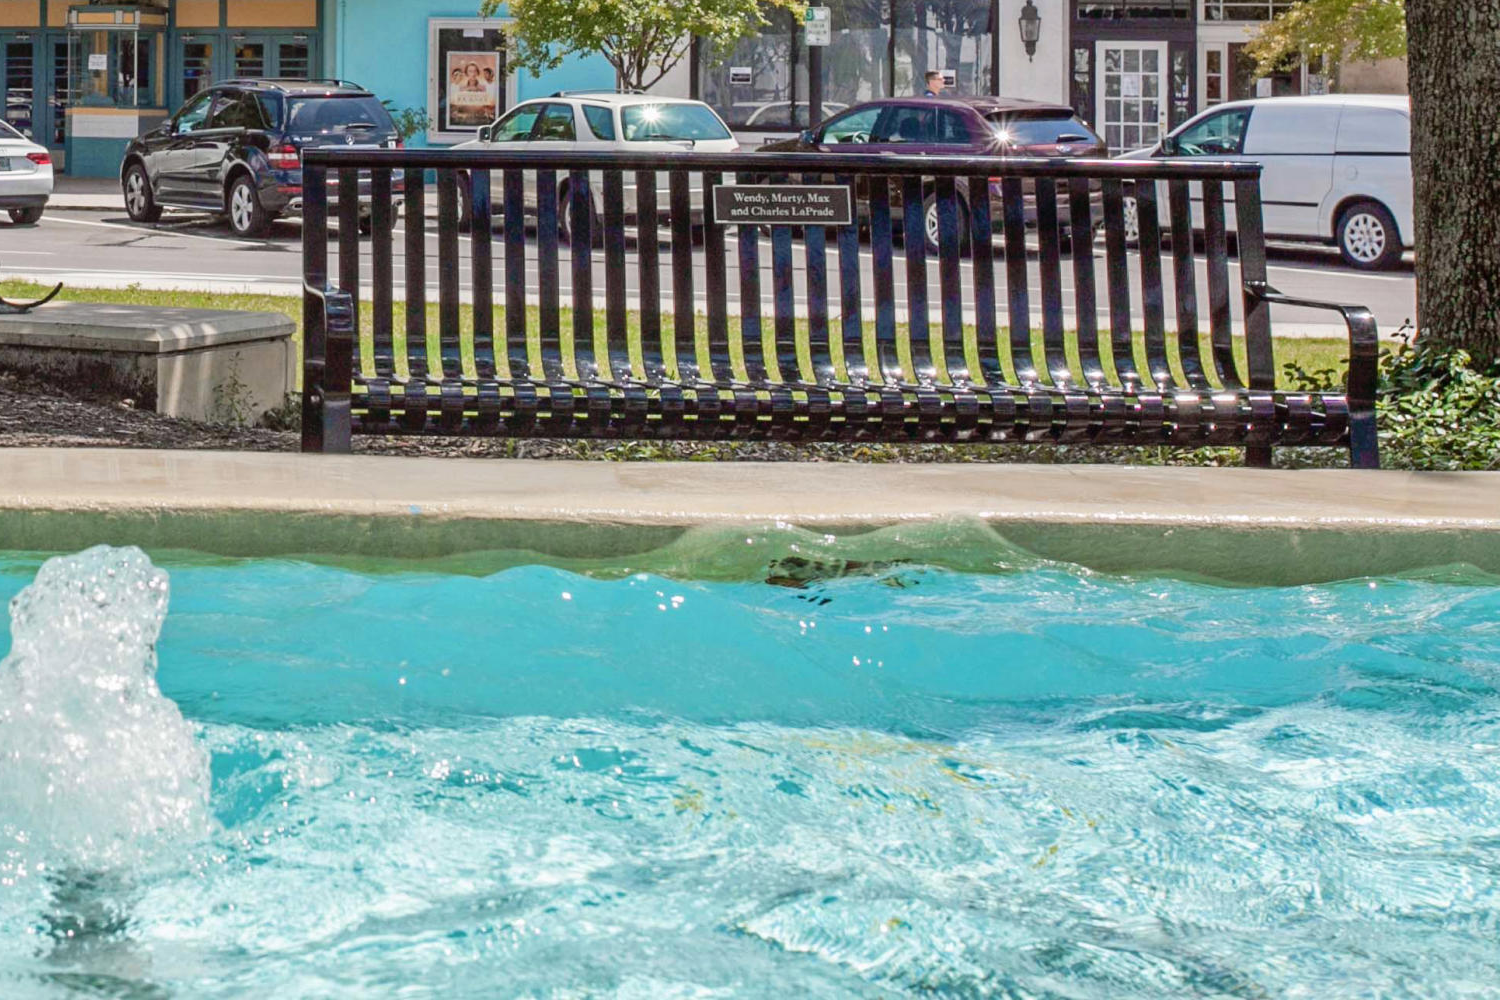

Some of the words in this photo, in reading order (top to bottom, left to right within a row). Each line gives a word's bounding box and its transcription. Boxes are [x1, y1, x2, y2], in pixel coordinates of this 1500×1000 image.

[733, 192, 769, 204] Wendy,
[771, 193, 805, 204] Marty,
[807, 193, 830, 203] Max
[730, 206, 749, 216] and
[751, 207, 789, 217] Charles
[791, 207, 835, 217] LaPrade
